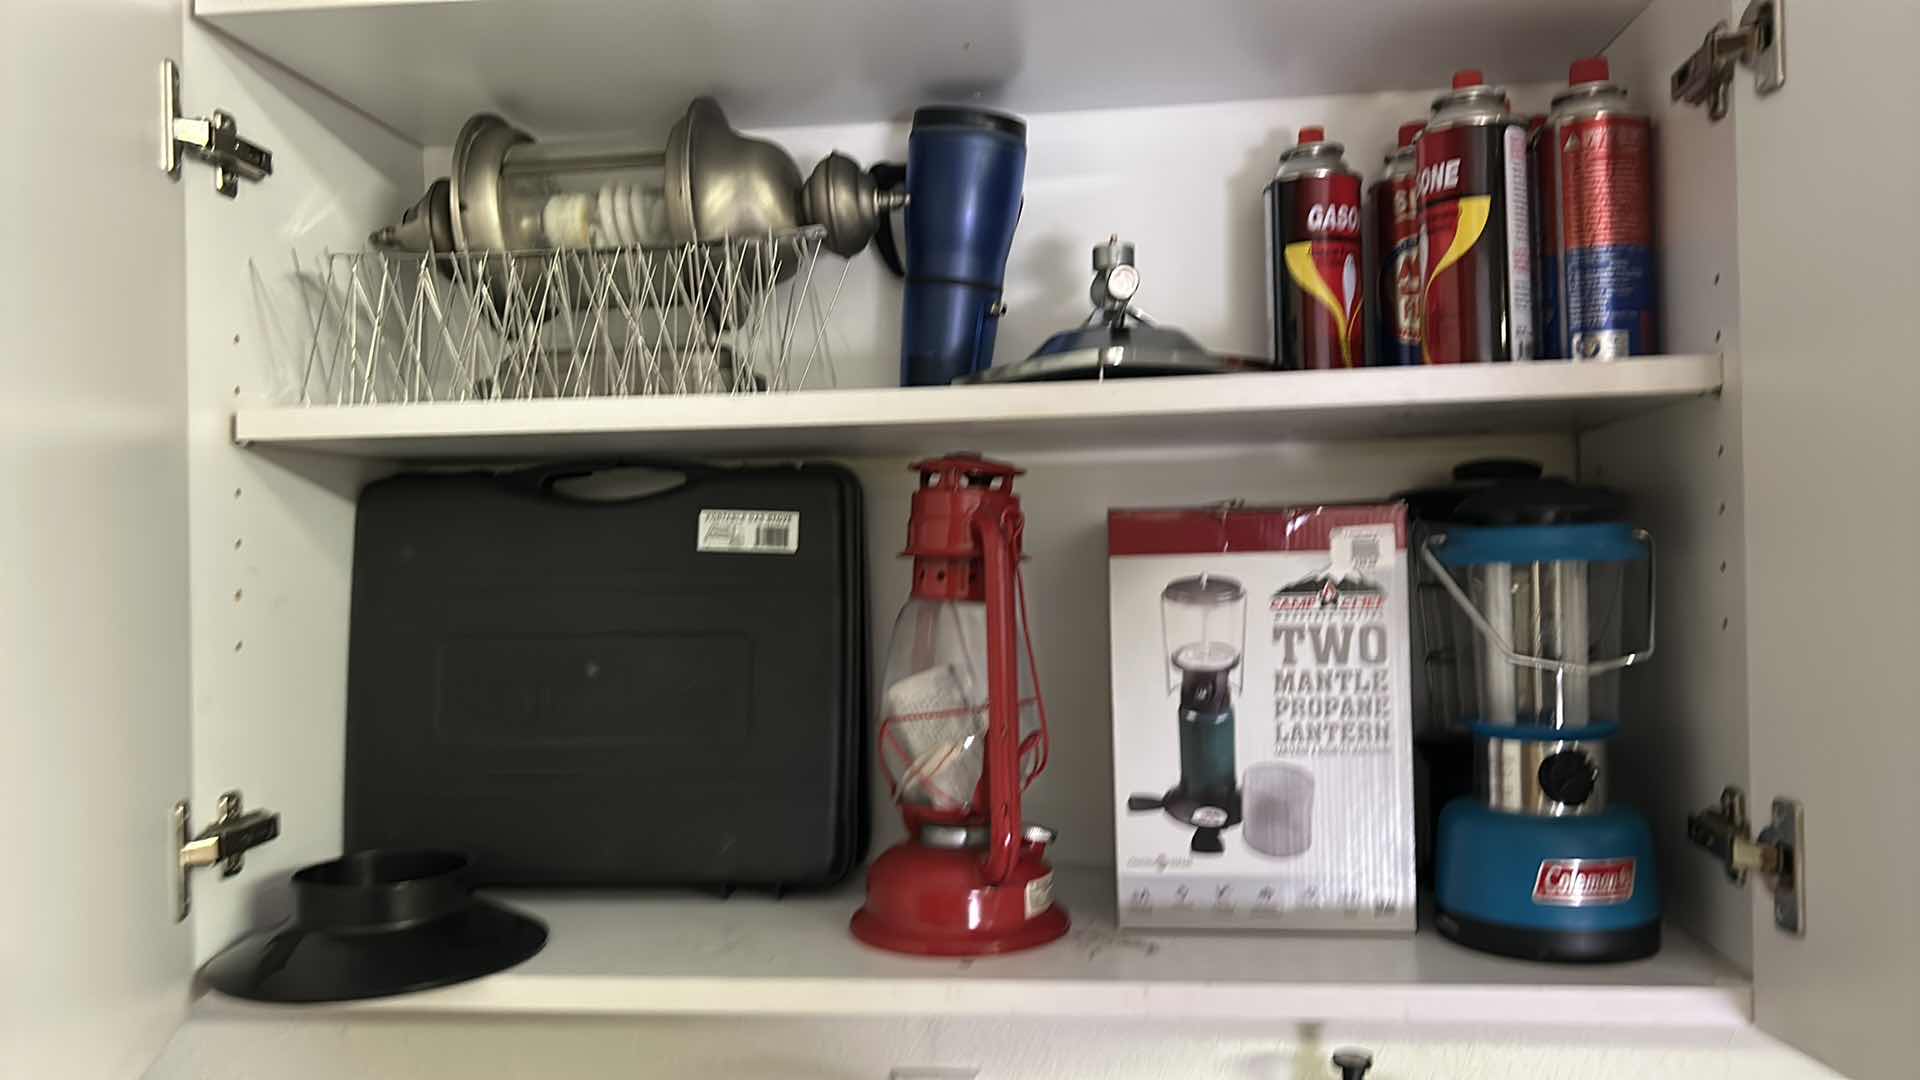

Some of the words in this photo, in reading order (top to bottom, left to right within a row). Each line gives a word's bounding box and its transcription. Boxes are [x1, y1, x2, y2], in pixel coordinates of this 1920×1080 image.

[1307, 203, 1360, 232] GASO
[1272, 625, 1388, 665] TWO
[1274, 669, 1389, 694] MANTLE
[1274, 696, 1391, 719] PROPANE
[1275, 721, 1391, 744] LANTERN
[1545, 864, 1617, 897] Coleman
